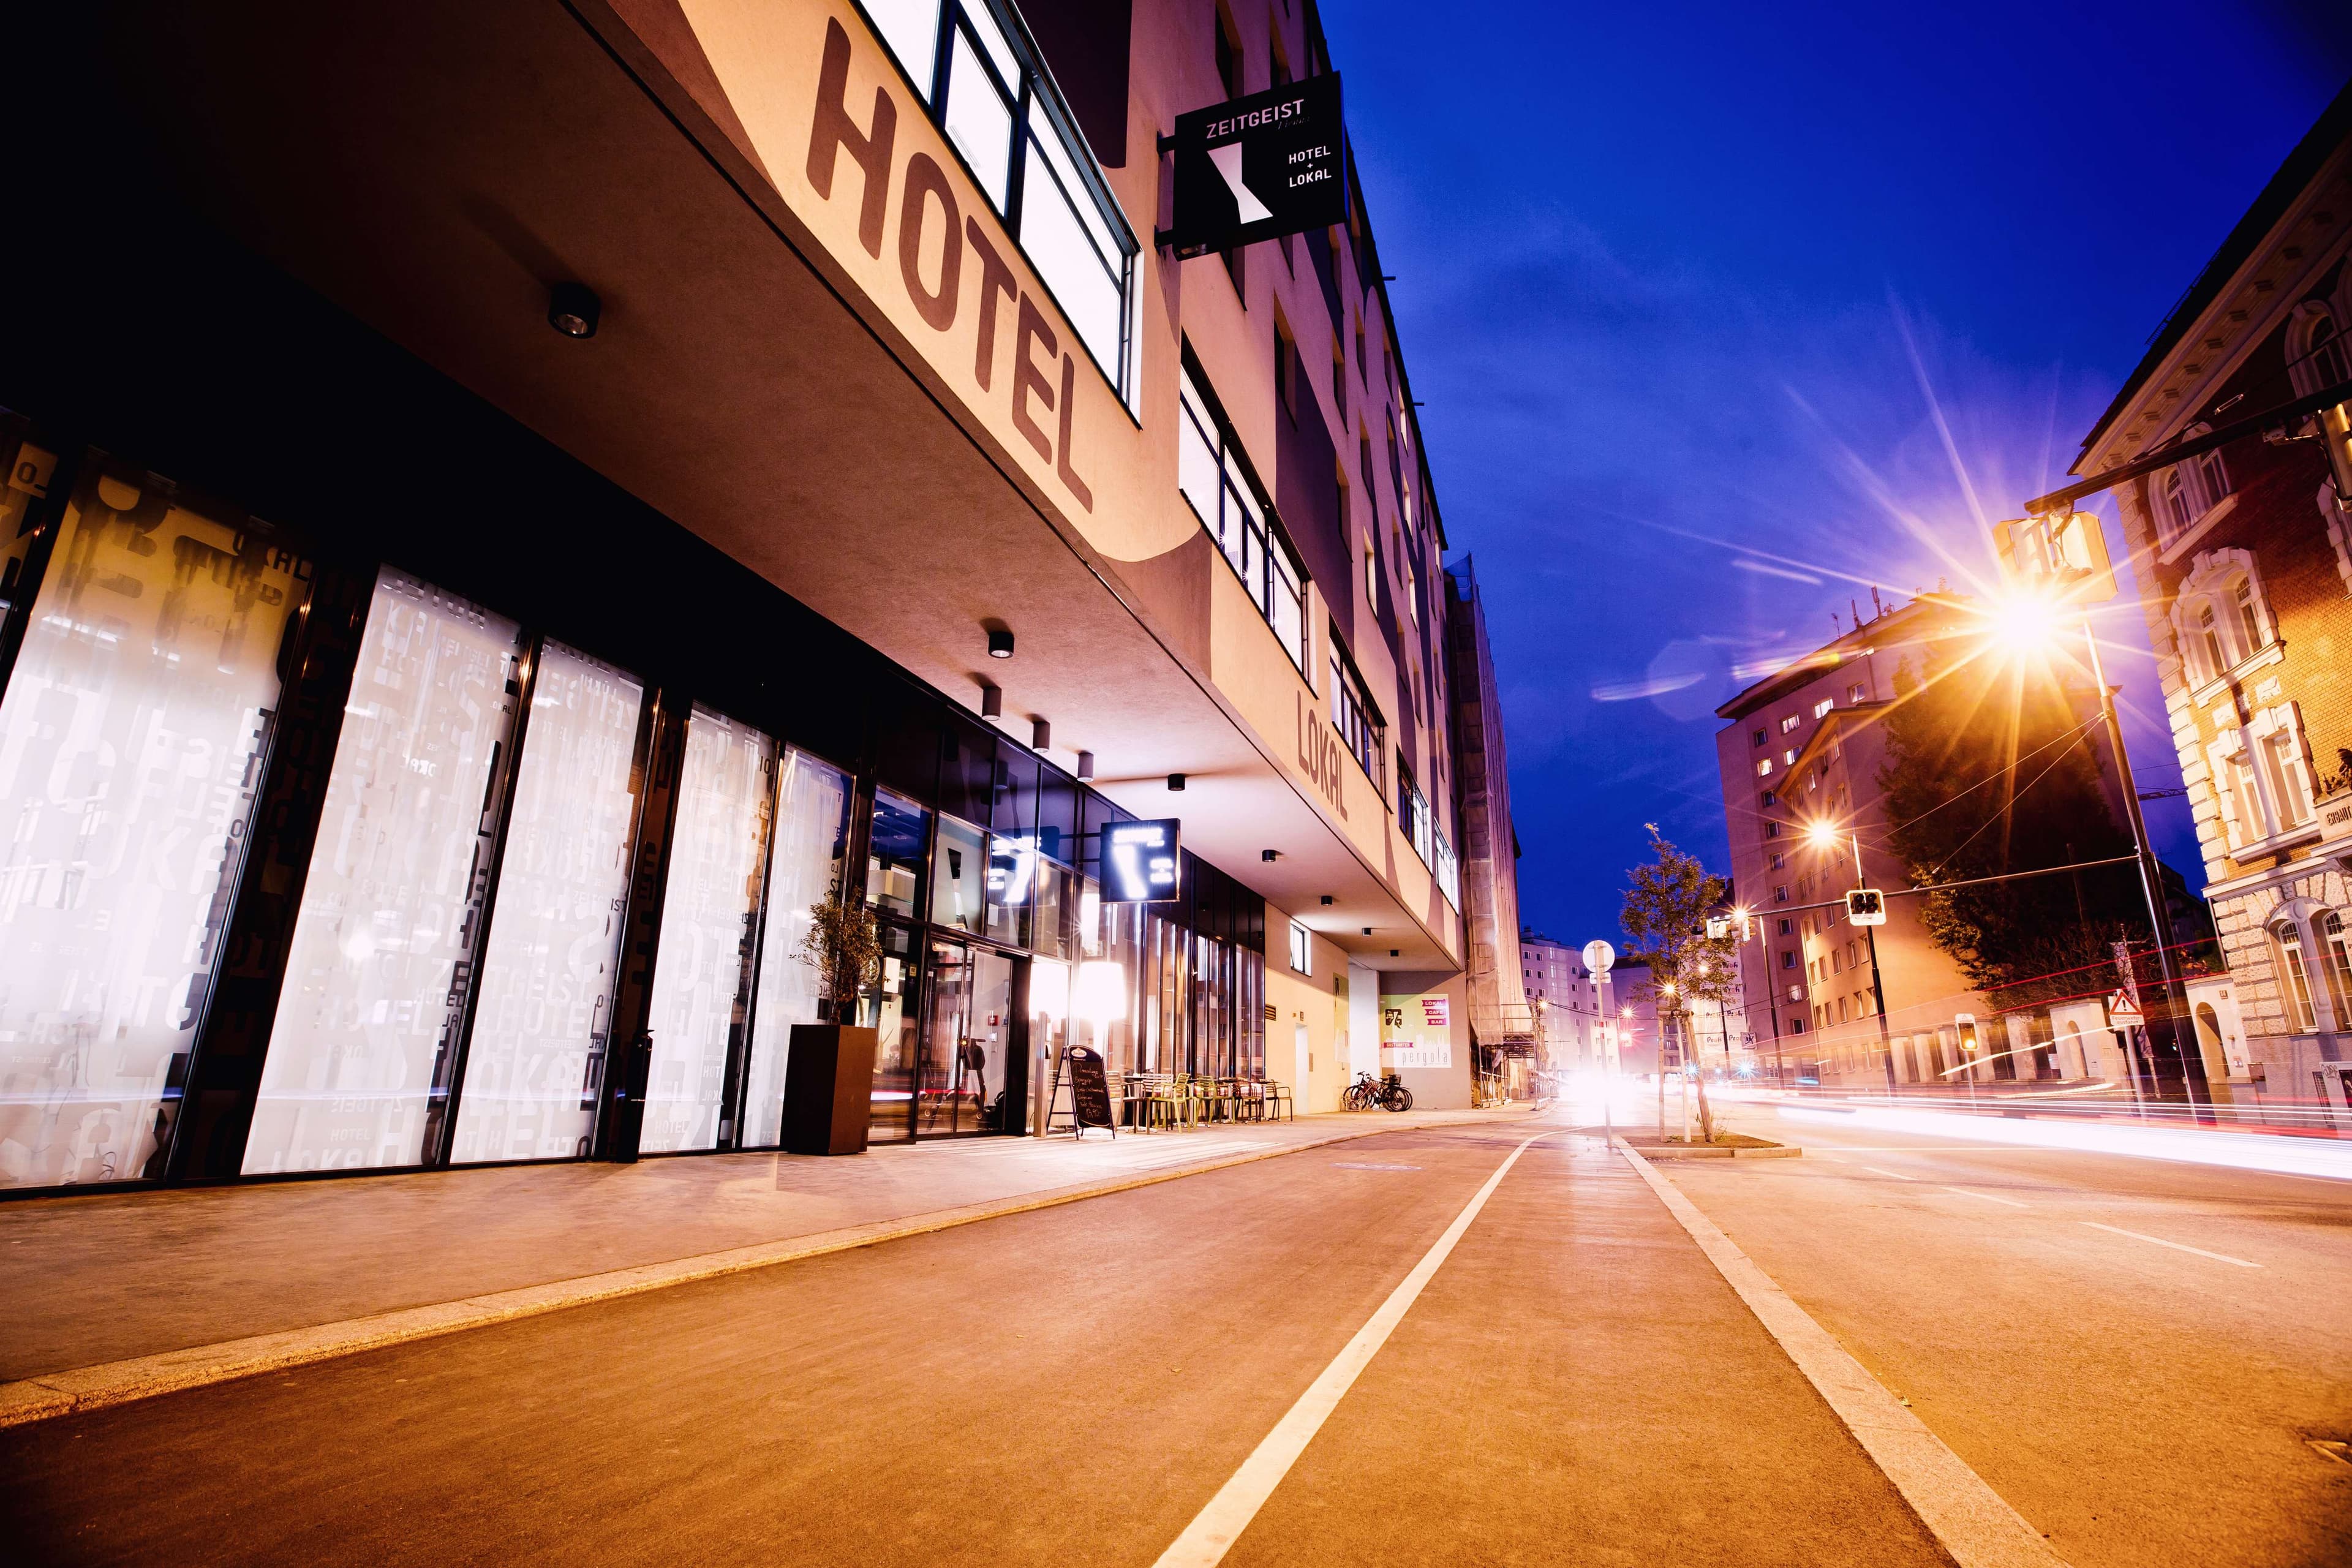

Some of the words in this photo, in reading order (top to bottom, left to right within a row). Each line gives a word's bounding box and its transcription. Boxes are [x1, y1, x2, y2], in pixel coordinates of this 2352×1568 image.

[1207, 99, 1305, 139] ZEITGEIST
[1289, 145, 1331, 164] HOTEL
[1289, 168, 1332, 187] LOKAL
[806, 15, 1093, 514] HOTEL
[1297, 690, 1348, 823] LOKAL
[2326, 805, 2352, 826] ERBAUT
[1402, 1046, 1448, 1066] pergola
[330, 1126, 373, 1142] HOTEL
